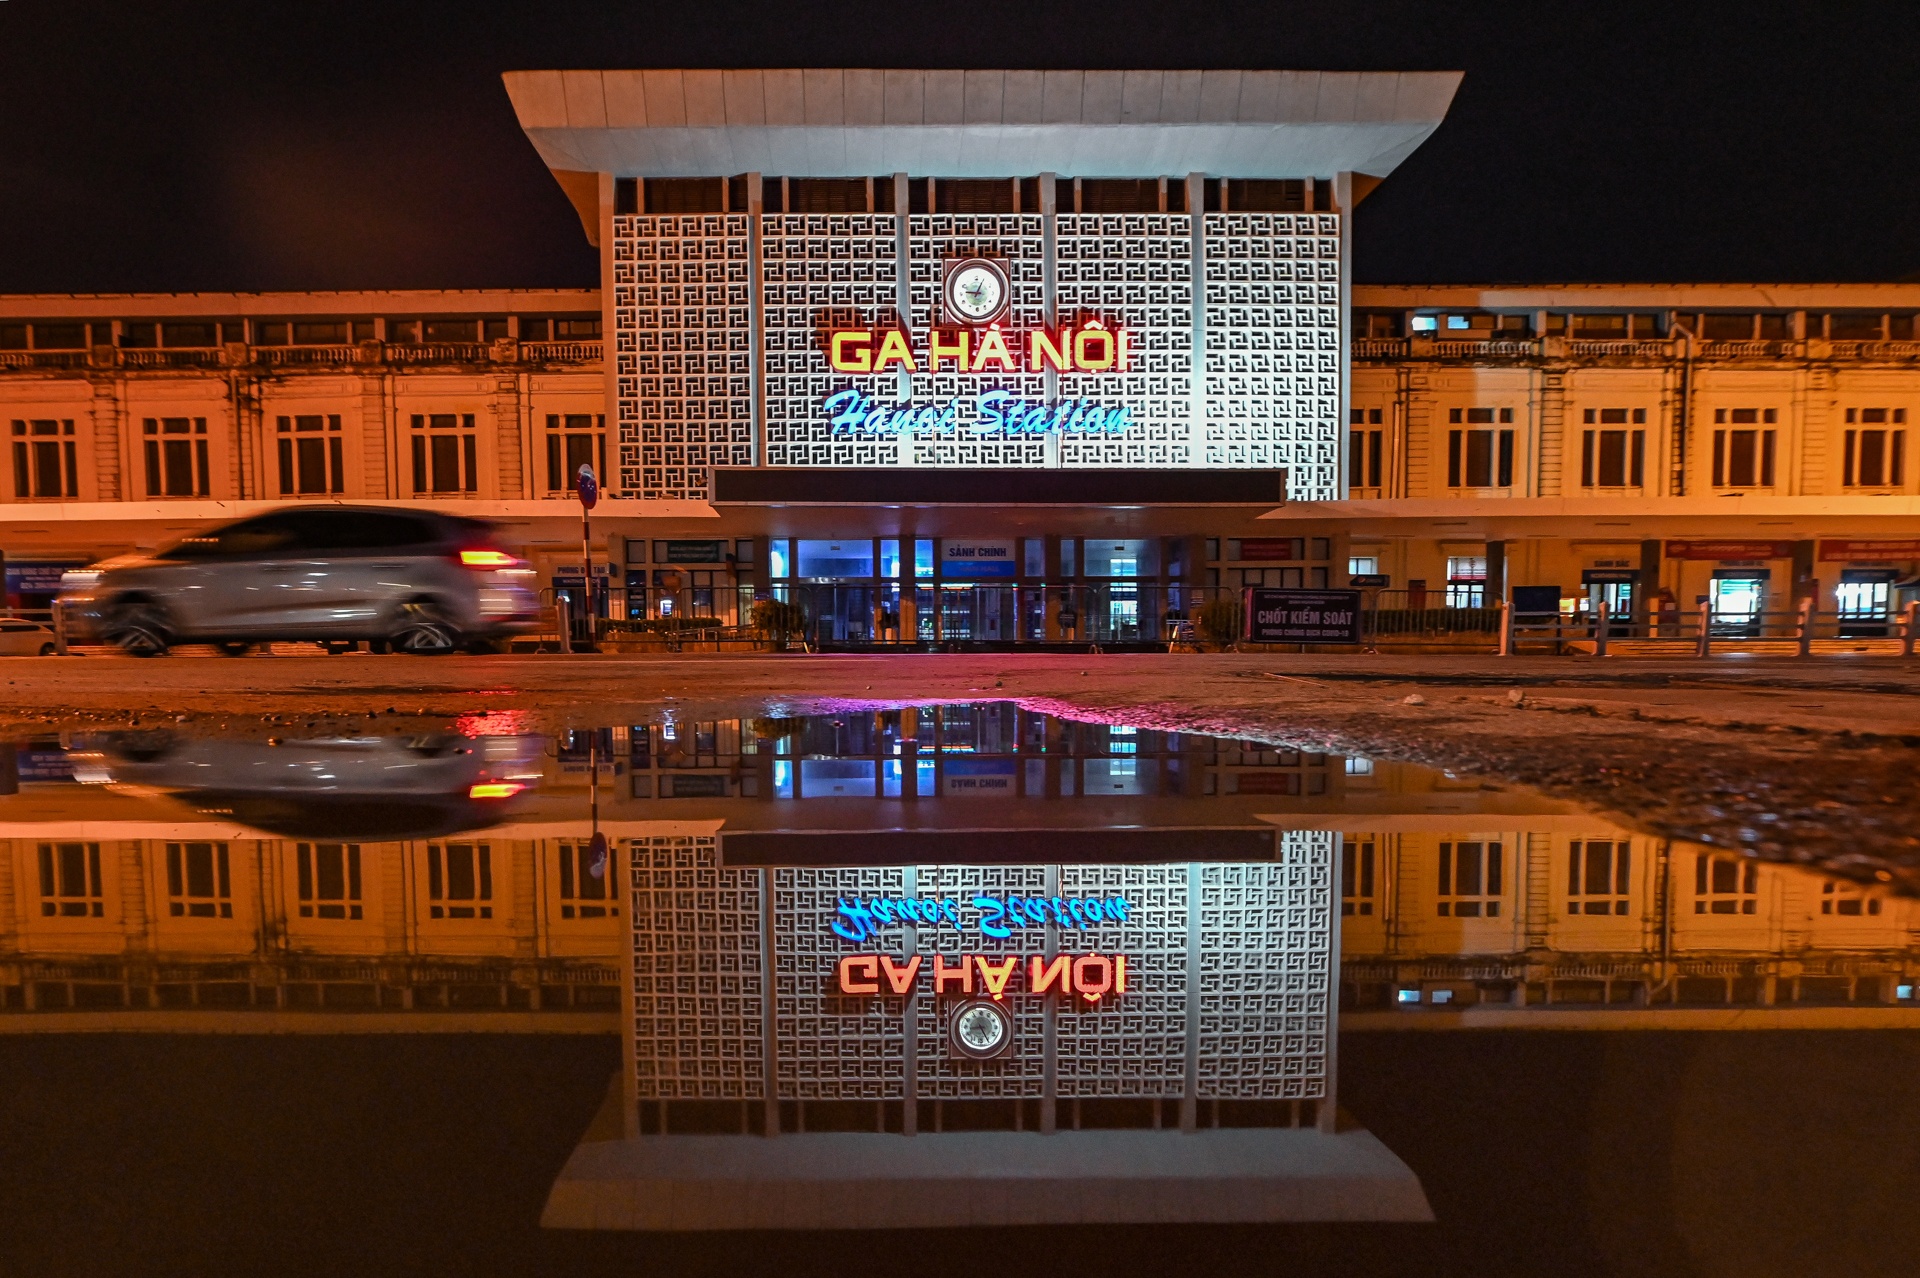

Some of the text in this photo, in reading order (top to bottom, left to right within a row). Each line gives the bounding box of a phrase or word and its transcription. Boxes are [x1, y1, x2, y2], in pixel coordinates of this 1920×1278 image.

[831, 320, 1128, 374] GA HÀ NỘI
[824, 389, 1133, 435] Hanoi Station
[1258, 606, 1288, 624] CHỐT
[1323, 609, 1353, 625] SOÁT
